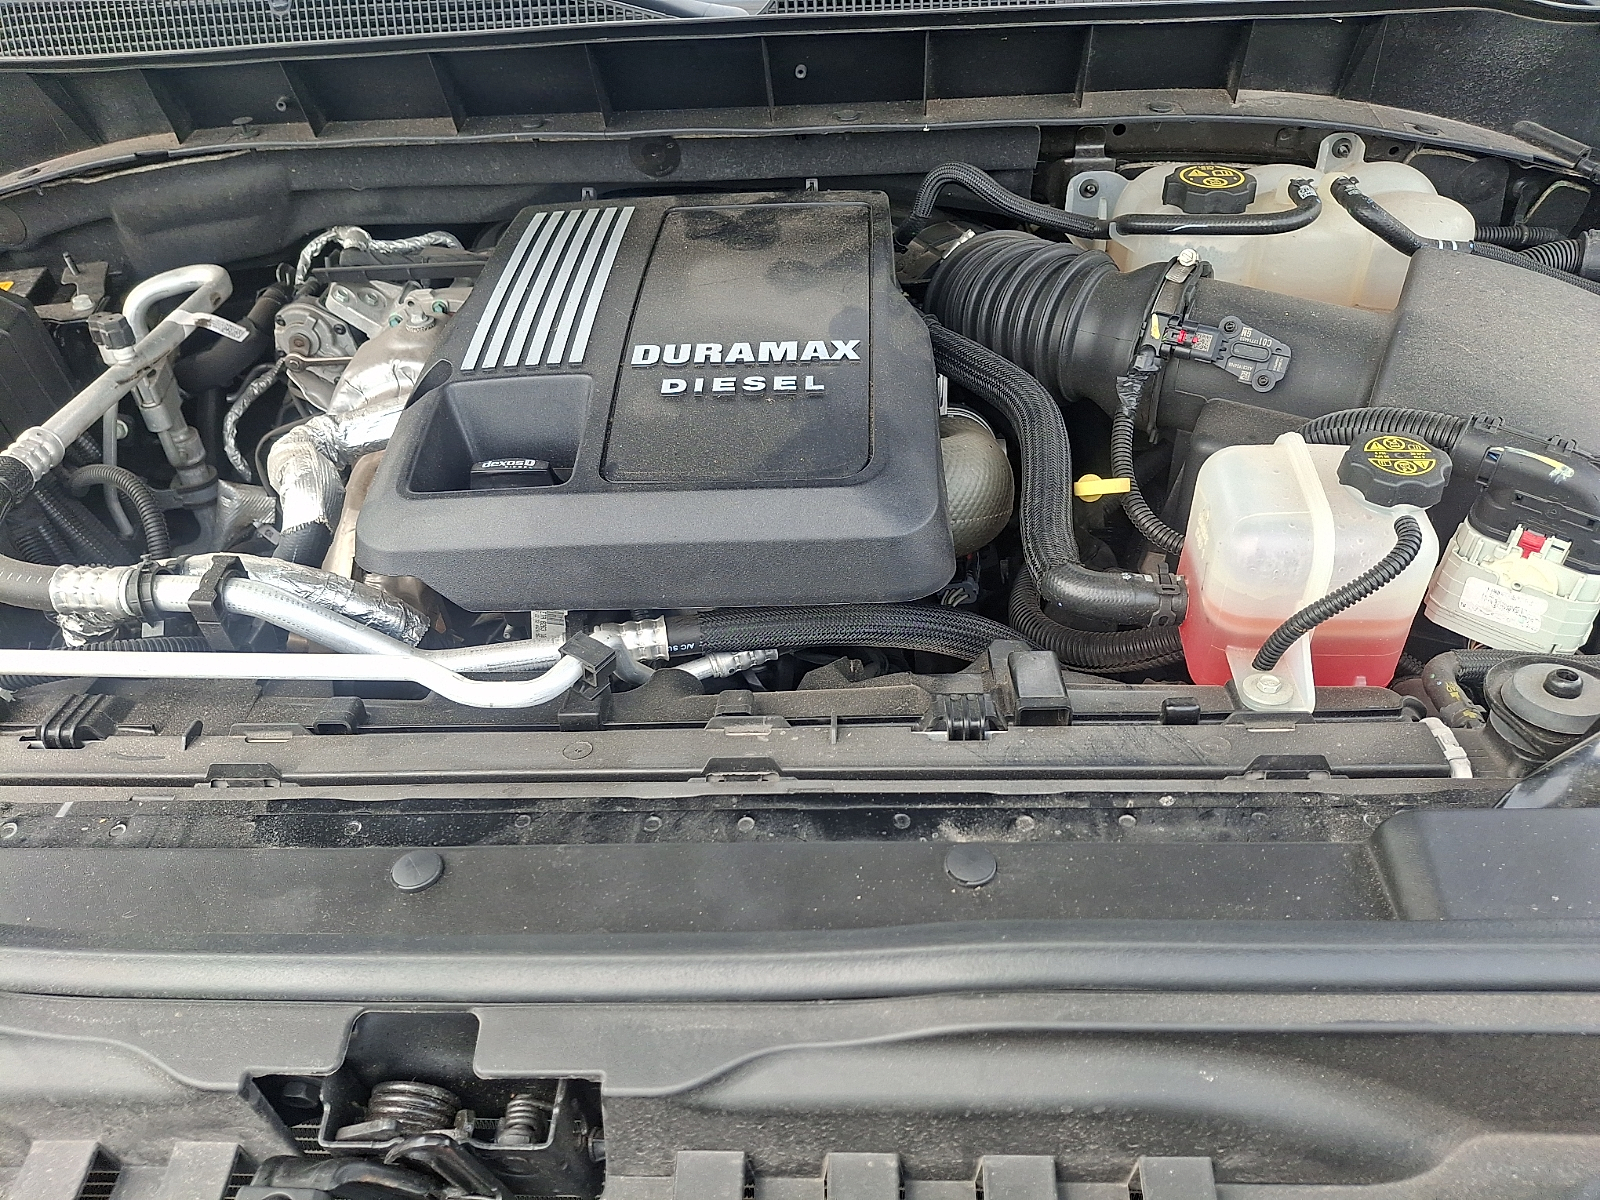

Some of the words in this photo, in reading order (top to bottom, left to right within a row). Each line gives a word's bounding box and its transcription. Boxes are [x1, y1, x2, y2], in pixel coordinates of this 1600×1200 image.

[631, 340, 861, 366] DURAMAX
[660, 375, 825, 395] DIESEL
[681, 642, 695, 651] A/C
